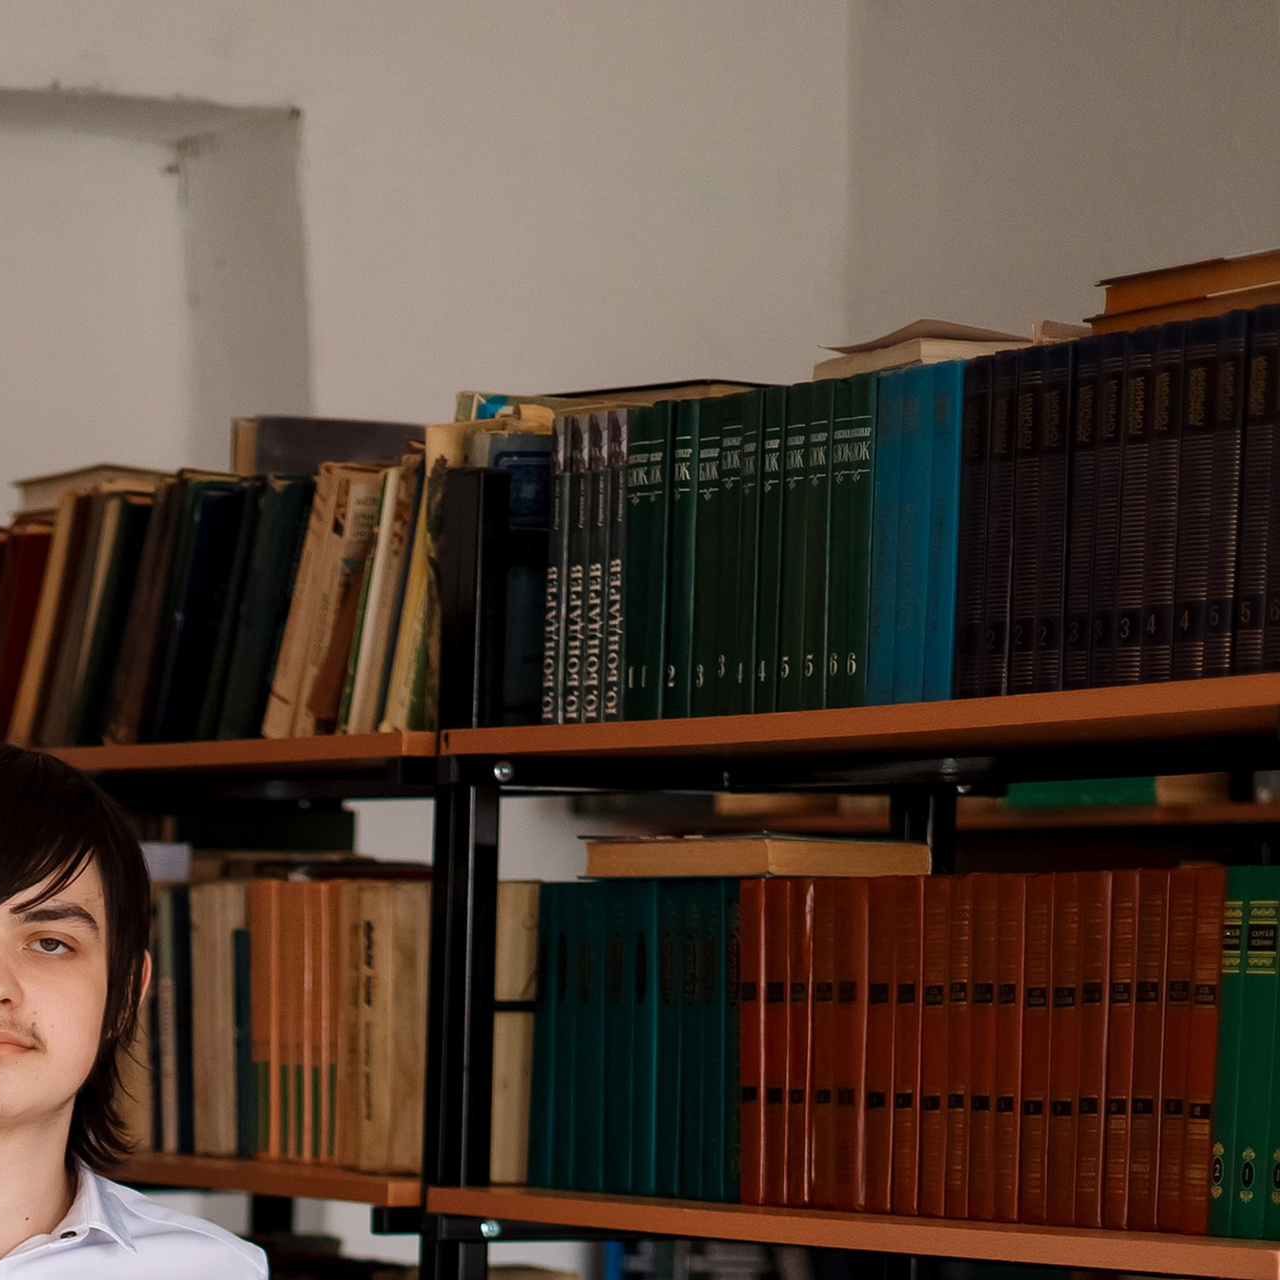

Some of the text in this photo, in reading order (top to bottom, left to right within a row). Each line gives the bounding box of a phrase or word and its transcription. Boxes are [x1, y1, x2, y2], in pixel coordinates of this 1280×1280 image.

[1180, 610, 1190, 632] 4
[1210, 605, 1219, 625] 5
[1240, 602, 1250, 623] 5
[1069, 621, 1078, 642] 3
[1120, 618, 1130, 638] 3
[1146, 614, 1156, 634] 4
[541, 566, 558, 719] Ю. БОНДАРЕВ
[565, 564, 585, 719] Ю. БОНДАРЕВ
[584, 562, 604, 718] Ю. БОНДАРЕВ
[605, 558, 624, 715] Ю. БОНДАРЕВ
[718, 654, 726, 678] 3
[758, 660, 766, 682] 4
[781, 656, 790, 678] 5
[805, 654, 814, 678] 5
[830, 652, 838, 676] 6
[847, 652, 856, 676] 6
[668, 664, 676, 688] 2
[696, 664, 704, 688] 3
[1251, 929, 1274, 938] СЕРГЕЙ
[1214, 1164, 1220, 1176] 2
[1245, 1168, 1250, 1181] 1
